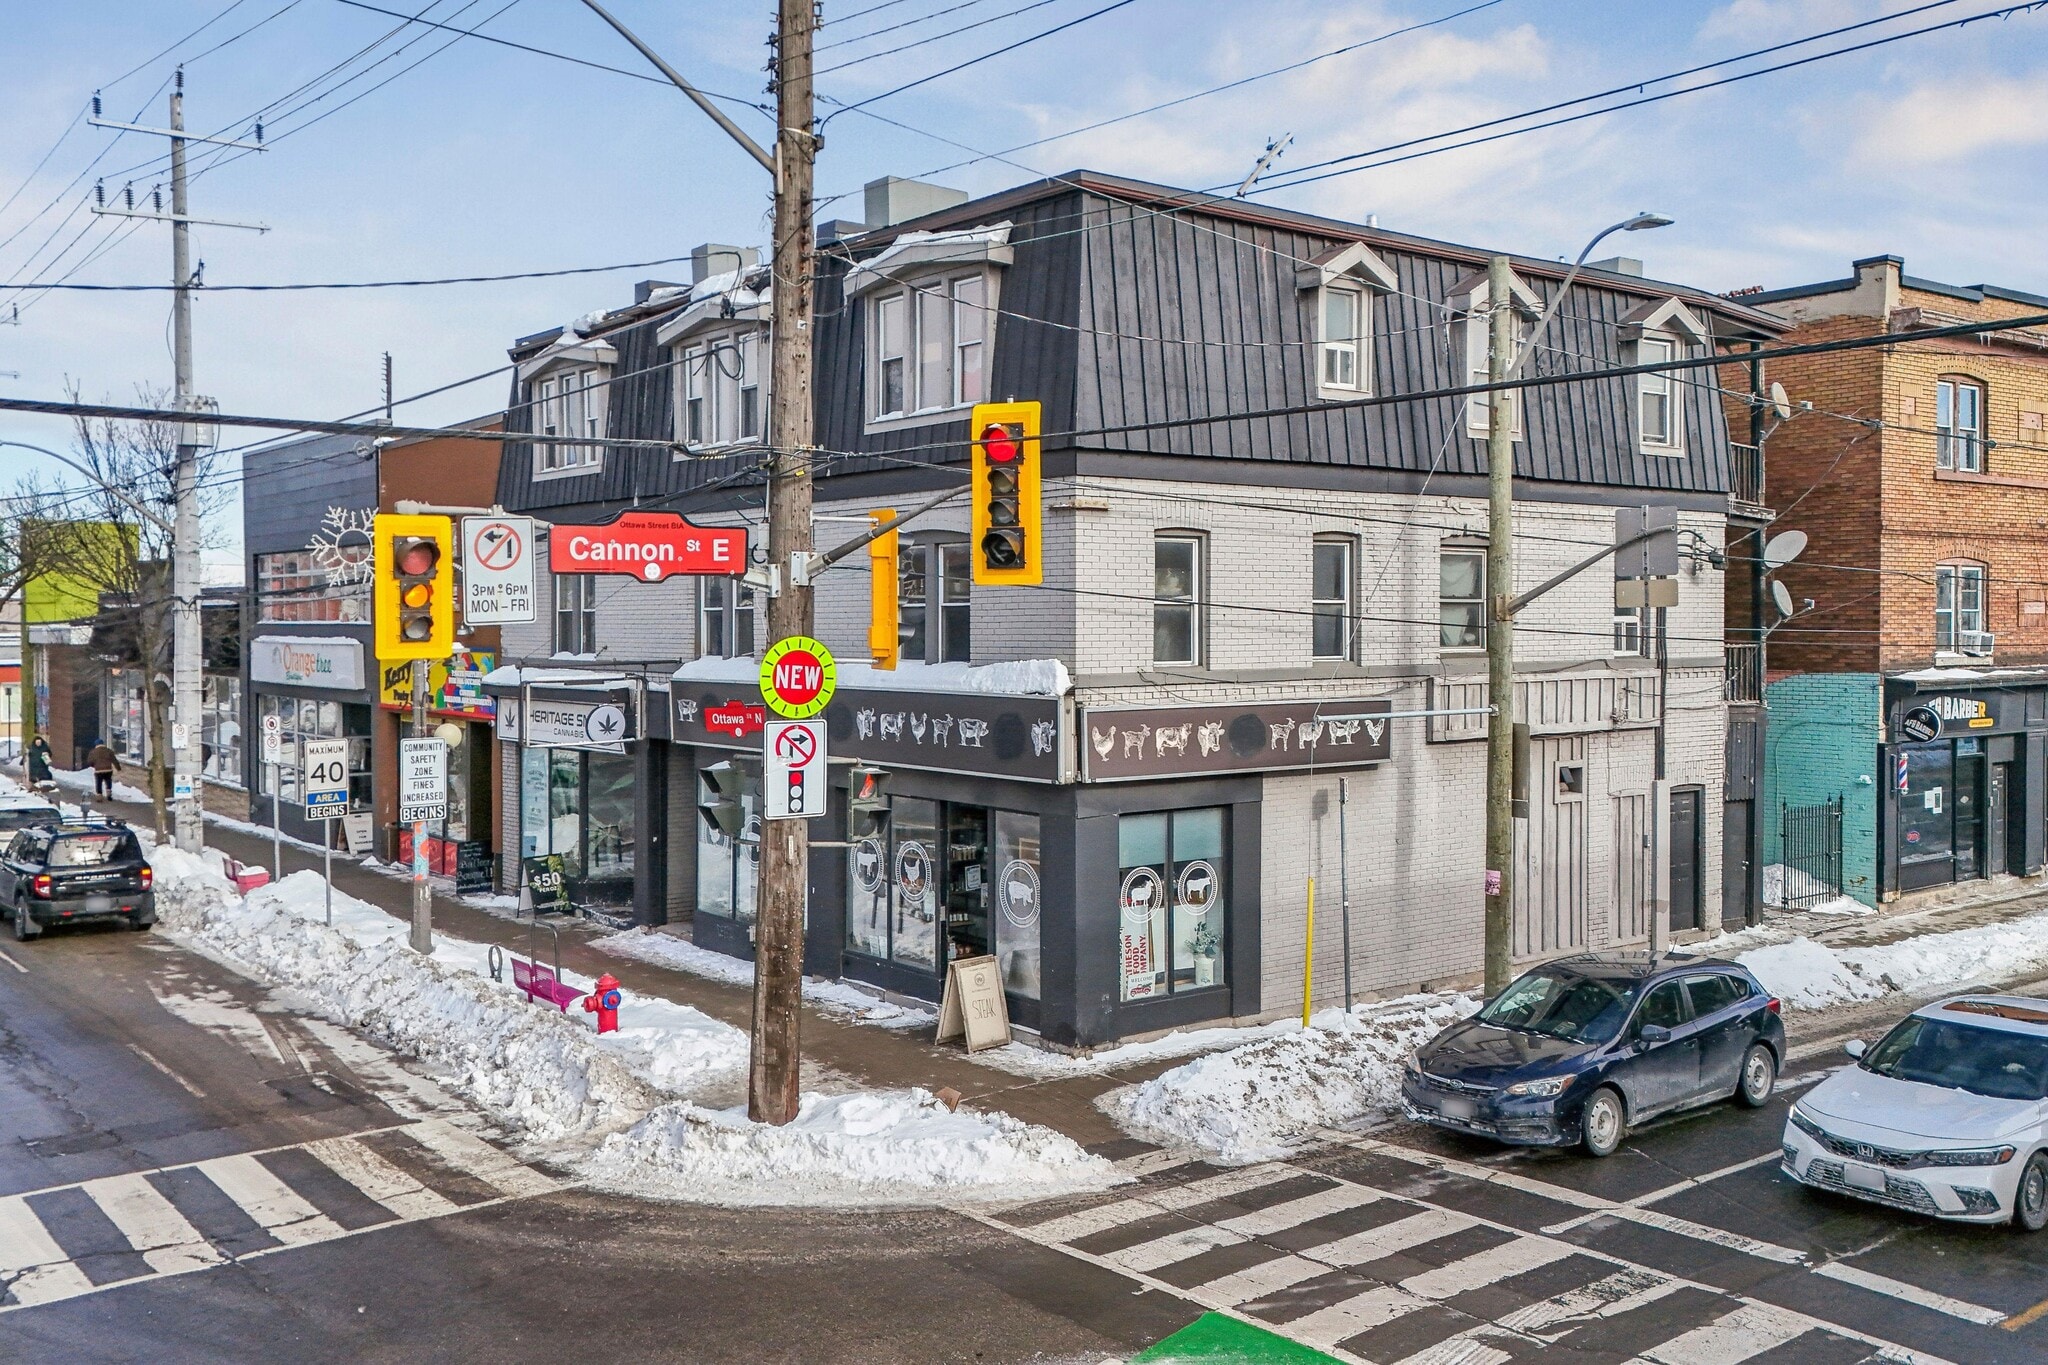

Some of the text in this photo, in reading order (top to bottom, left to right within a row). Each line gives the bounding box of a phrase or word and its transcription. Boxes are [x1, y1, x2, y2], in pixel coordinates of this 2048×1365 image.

[619, 521, 685, 530] Ottawa Street BIA
[569, 536, 730, 562] Cannon St E
[472, 583, 496, 597] 3PM
[505, 582, 528, 596] 6PM
[471, 599, 499, 613] MON
[510, 598, 529, 612] FRI
[283, 643, 332, 677] Orange tree
[775, 663, 821, 691] NEW
[1944, 696, 1986, 720] BARBER
[712, 713, 745, 724] Ottawa
[754, 712, 763, 724] N
[553, 727, 585, 739] CANNABIS
[309, 745, 345, 755] MAXIMUM
[404, 742, 443, 753] COMMUNITY
[410, 755, 436, 764] SAFETY
[310, 761, 344, 783] 40
[414, 766, 433, 776] ZONE
[413, 780, 435, 790] FINES
[315, 792, 340, 803] AREA
[404, 791, 444, 802] INCREASED
[310, 805, 345, 818] BEGINS
[402, 805, 444, 820] BEGINS
[533, 871, 561, 888] $50
[1132, 946, 1140, 975] FOOD
[1130, 975, 1154, 983] WELCOME
[971, 997, 997, 1020] STEAK
